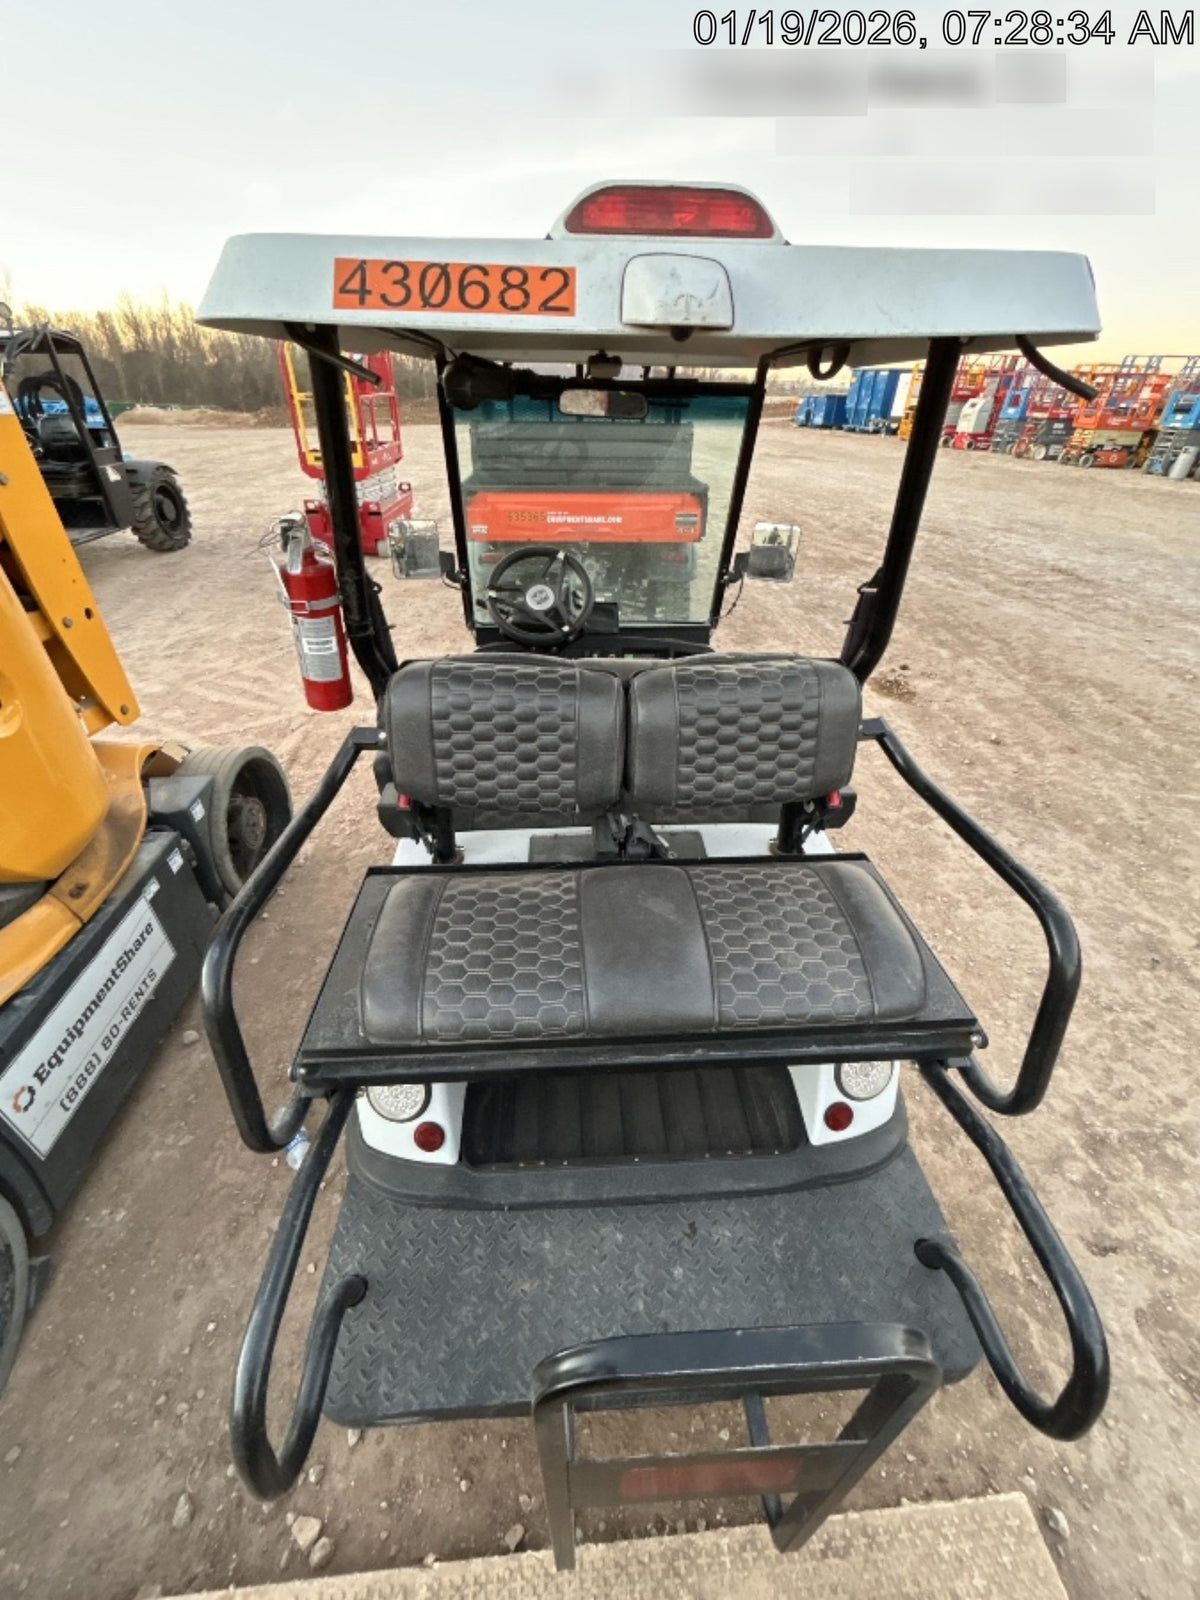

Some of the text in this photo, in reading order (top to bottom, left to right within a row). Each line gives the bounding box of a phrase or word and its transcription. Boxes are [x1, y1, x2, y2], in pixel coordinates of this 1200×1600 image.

[338, 259, 570, 312] 430682
[33, 922, 154, 1086] EquipmentShare
[59, 968, 158, 1112] (888) 80-RENTS
